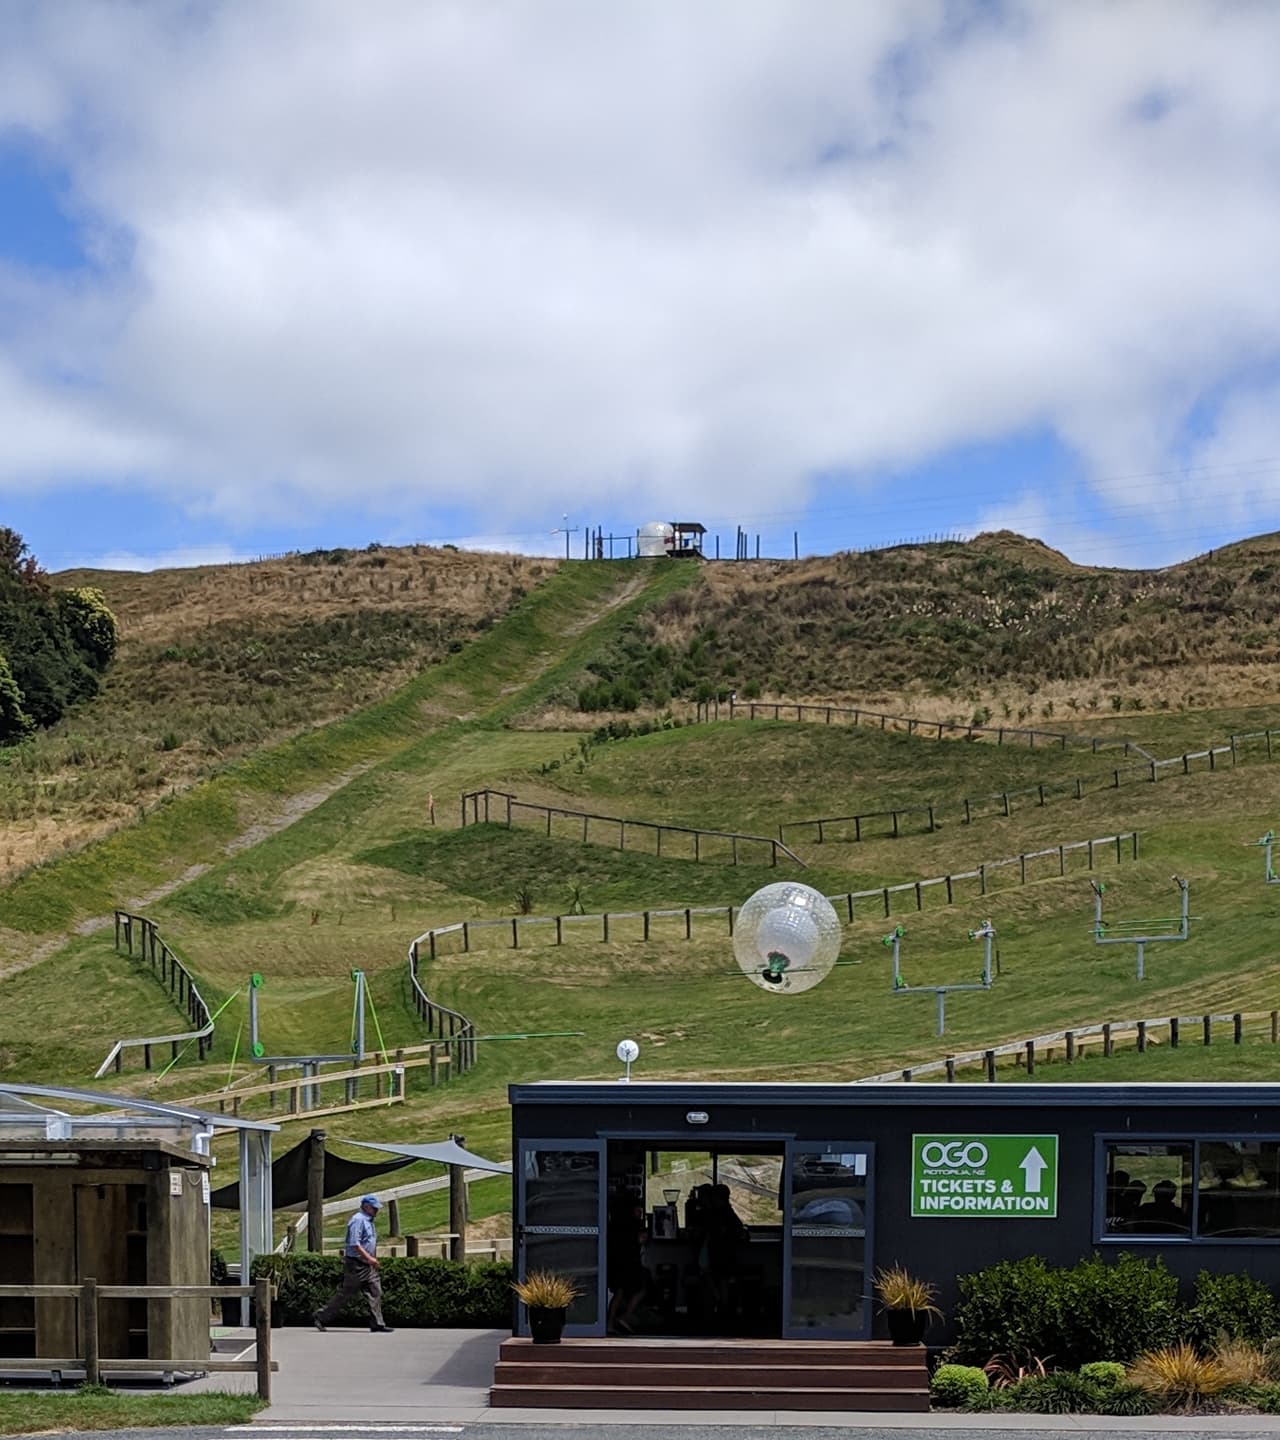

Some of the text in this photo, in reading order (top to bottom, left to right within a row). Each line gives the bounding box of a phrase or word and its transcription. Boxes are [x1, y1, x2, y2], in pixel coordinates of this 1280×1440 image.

[921, 1141, 989, 1168] OGO
[920, 1179, 1014, 1193] TICKETS &
[920, 1196, 1049, 1210] INFORMATION
